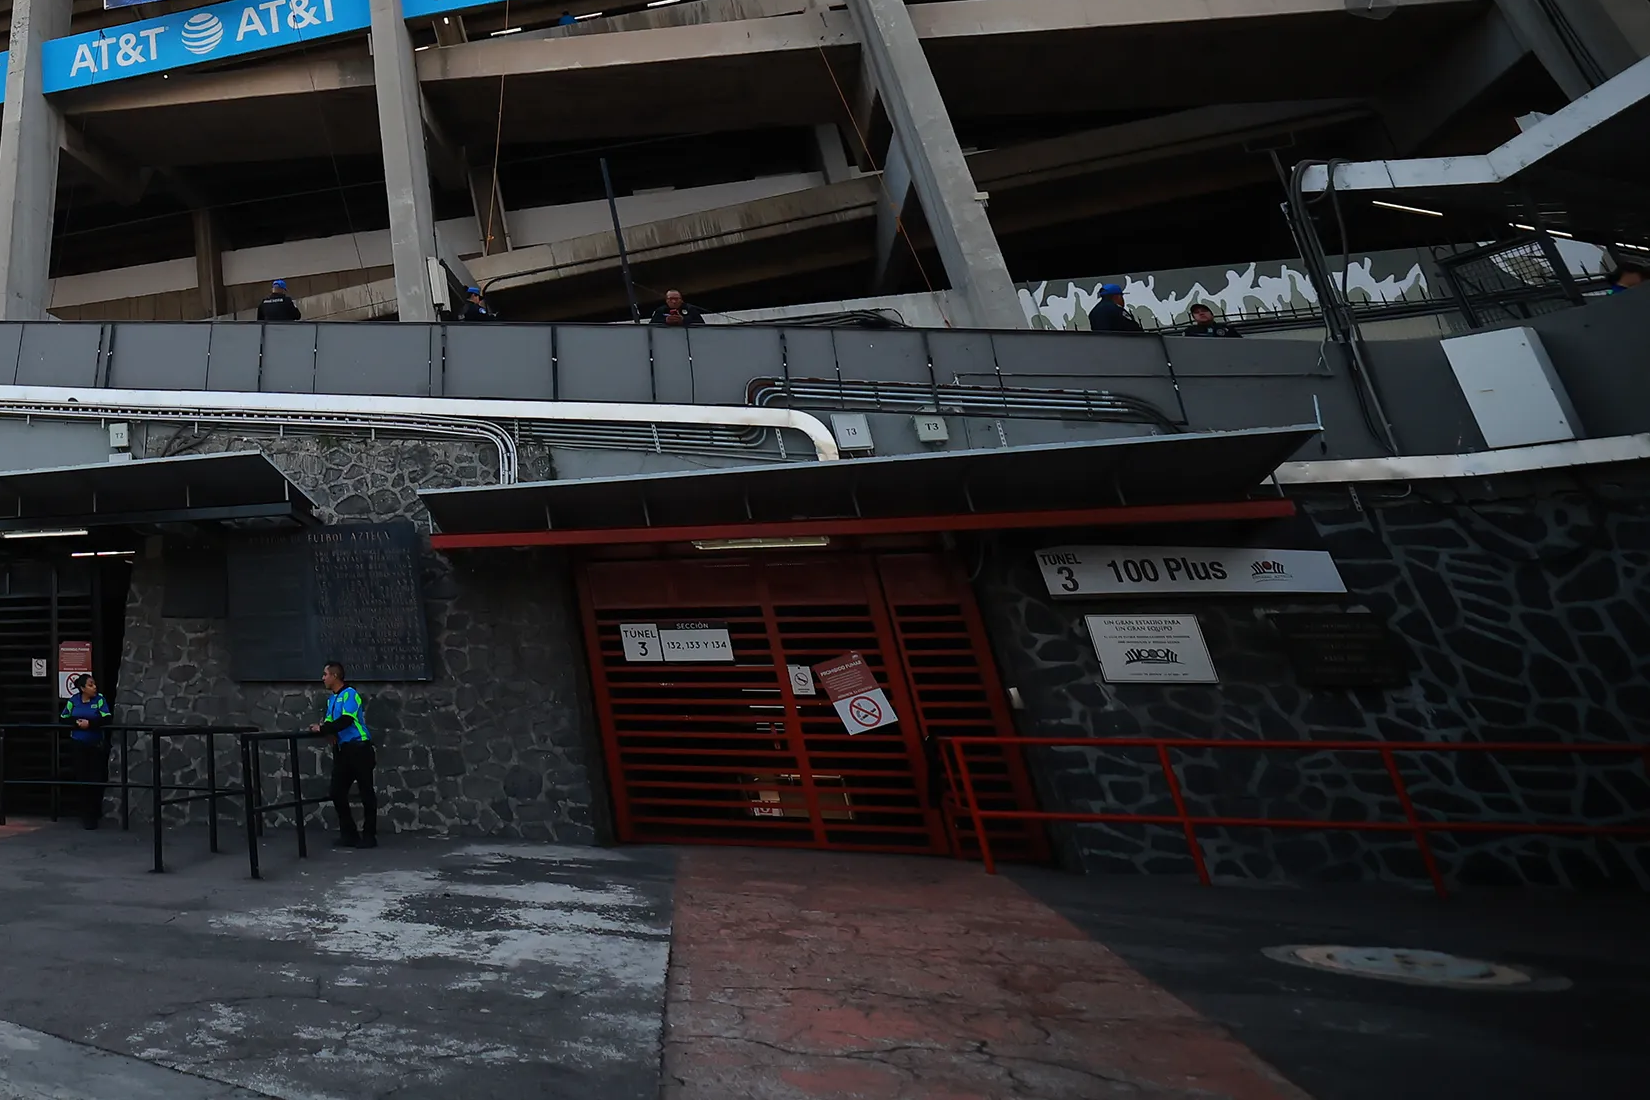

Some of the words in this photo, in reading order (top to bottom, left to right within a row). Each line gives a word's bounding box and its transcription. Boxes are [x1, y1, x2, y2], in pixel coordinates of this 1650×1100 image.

[69, 26, 165, 77] AT&T
[845, 427, 857, 436] T3
[925, 422, 939, 431] T3
[1107, 558, 1160, 584] 100
[1163, 556, 1228, 582] Plus
[1057, 566, 1079, 592] 3
[623, 628, 657, 638] TÚNEL
[638, 642, 649, 656] 3
[711, 641, 727, 649] 134
